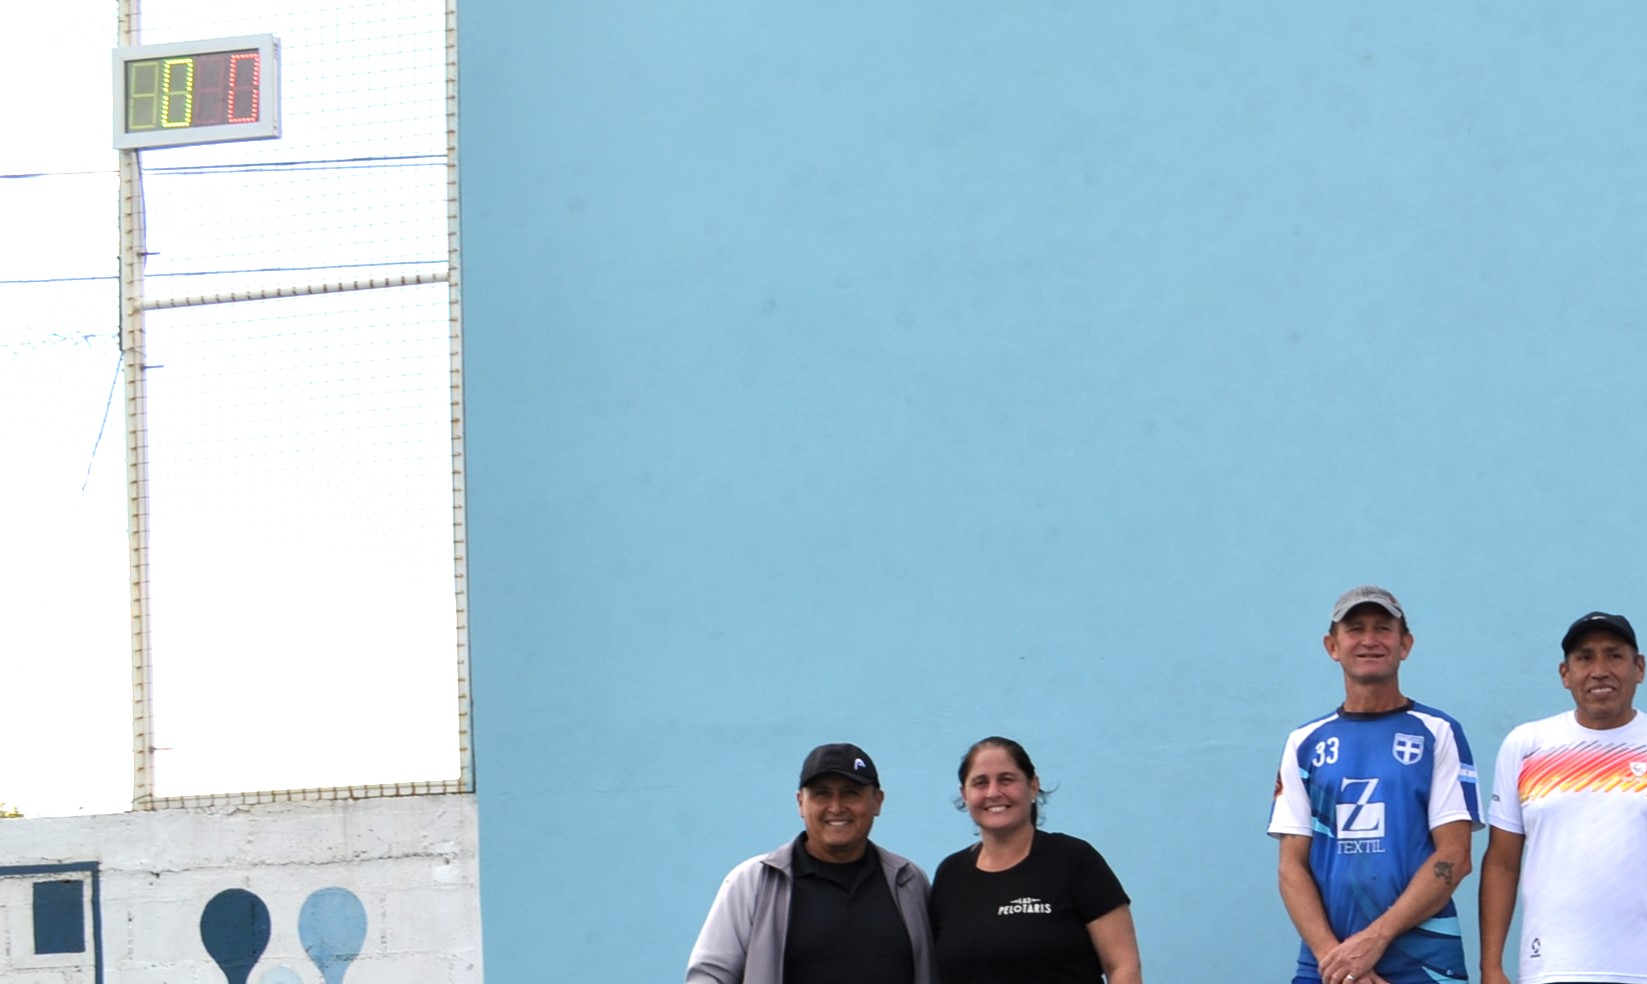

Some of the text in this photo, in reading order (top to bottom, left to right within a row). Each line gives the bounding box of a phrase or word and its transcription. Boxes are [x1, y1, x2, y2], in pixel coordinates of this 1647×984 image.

[1311, 736, 1340, 768] 33
[1340, 776, 1380, 831] Z
[1336, 839, 1386, 855] TEXTIL
[997, 903, 1052, 915] PELOTARIS
